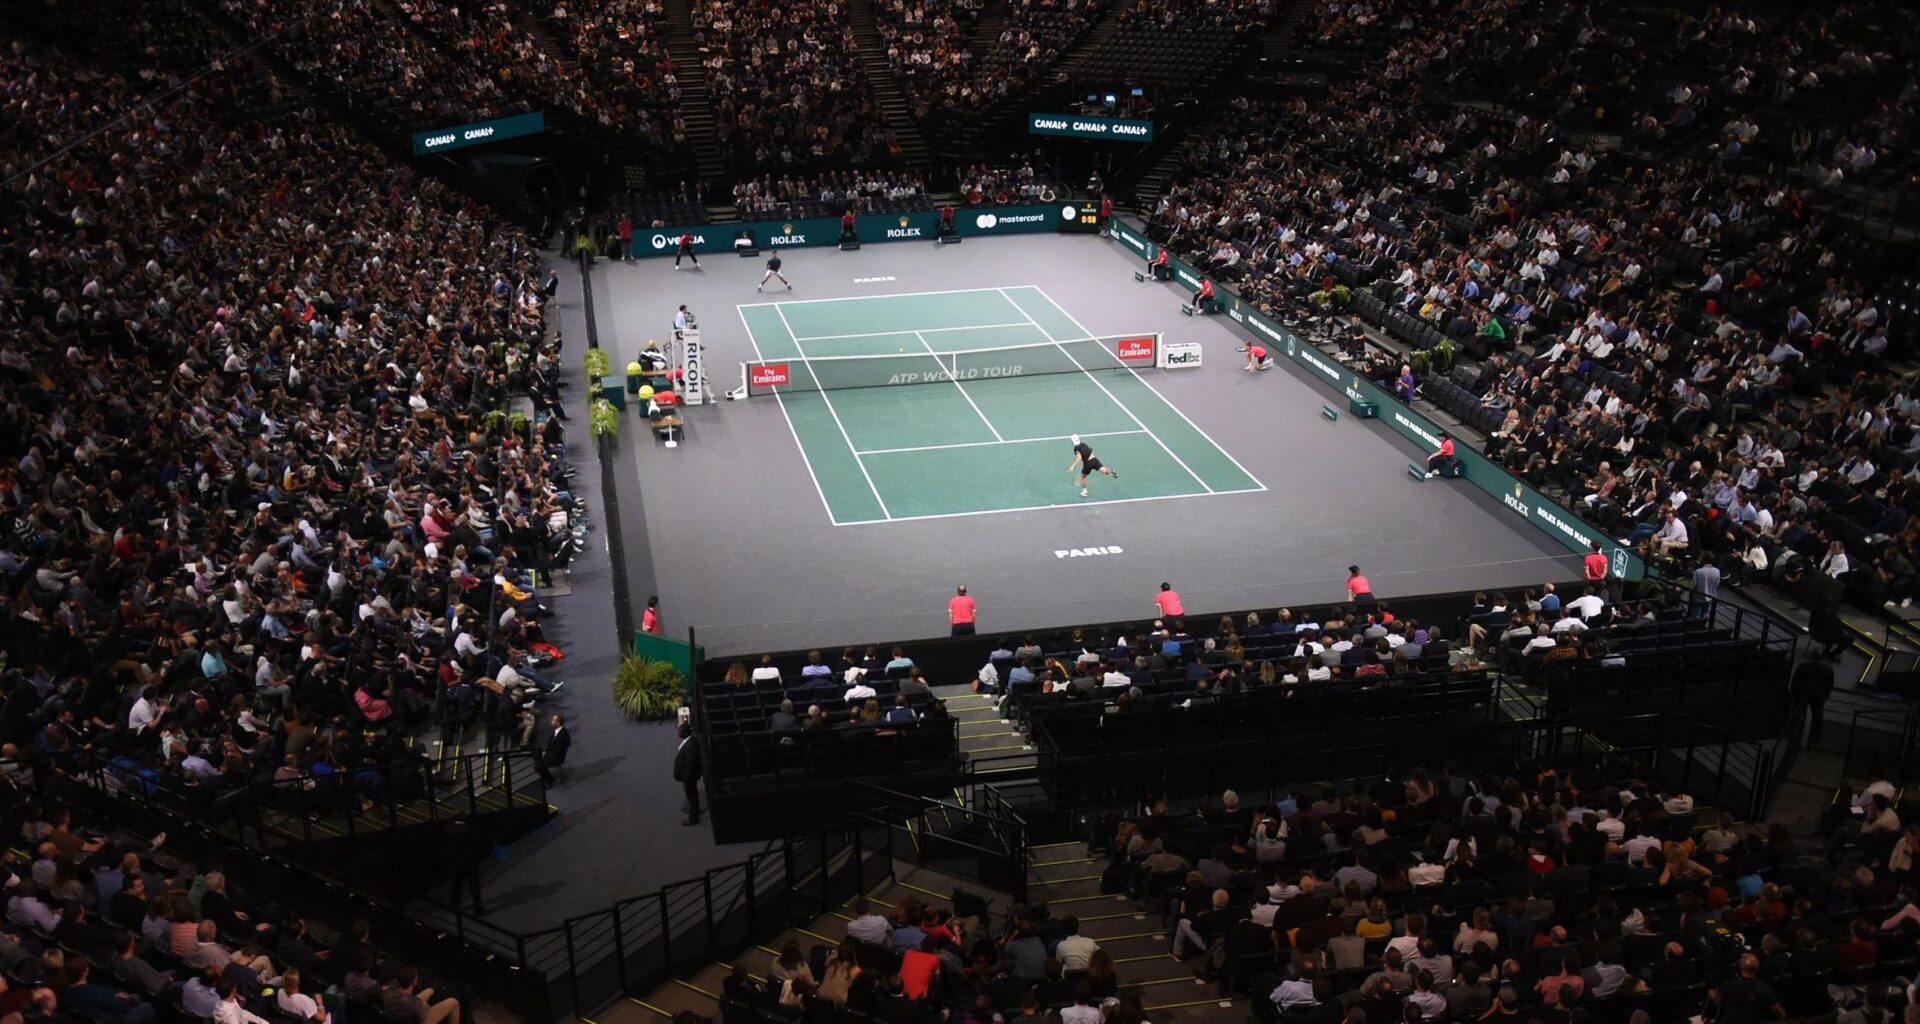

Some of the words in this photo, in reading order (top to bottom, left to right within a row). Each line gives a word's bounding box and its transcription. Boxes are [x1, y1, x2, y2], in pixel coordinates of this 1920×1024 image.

[1035, 119, 1068, 130] CANAL+
[1073, 121, 1107, 132] CANAL+
[1112, 124, 1147, 135] CANAL+
[425, 134, 456, 147] CANAL+
[464, 126, 494, 140] CANAL+
[999, 213, 1044, 224] mastercard
[887, 227, 921, 238] ROLEX
[771, 235, 806, 245] ROLEX
[1119, 348, 1151, 357] Emirates
[1168, 351, 1200, 364] FedEx
[687, 342, 699, 394] RICOH
[889, 372, 918, 385] ATP
[923, 368, 978, 382] WORLD
[983, 365, 1023, 378] TOUR
[753, 374, 786, 384] Emirates
[1504, 493, 1529, 517] ROLEX
[1537, 507, 1557, 526] ROLEX
[1556, 519, 1575, 537] PARIS
[1054, 545, 1123, 559] PARIS
